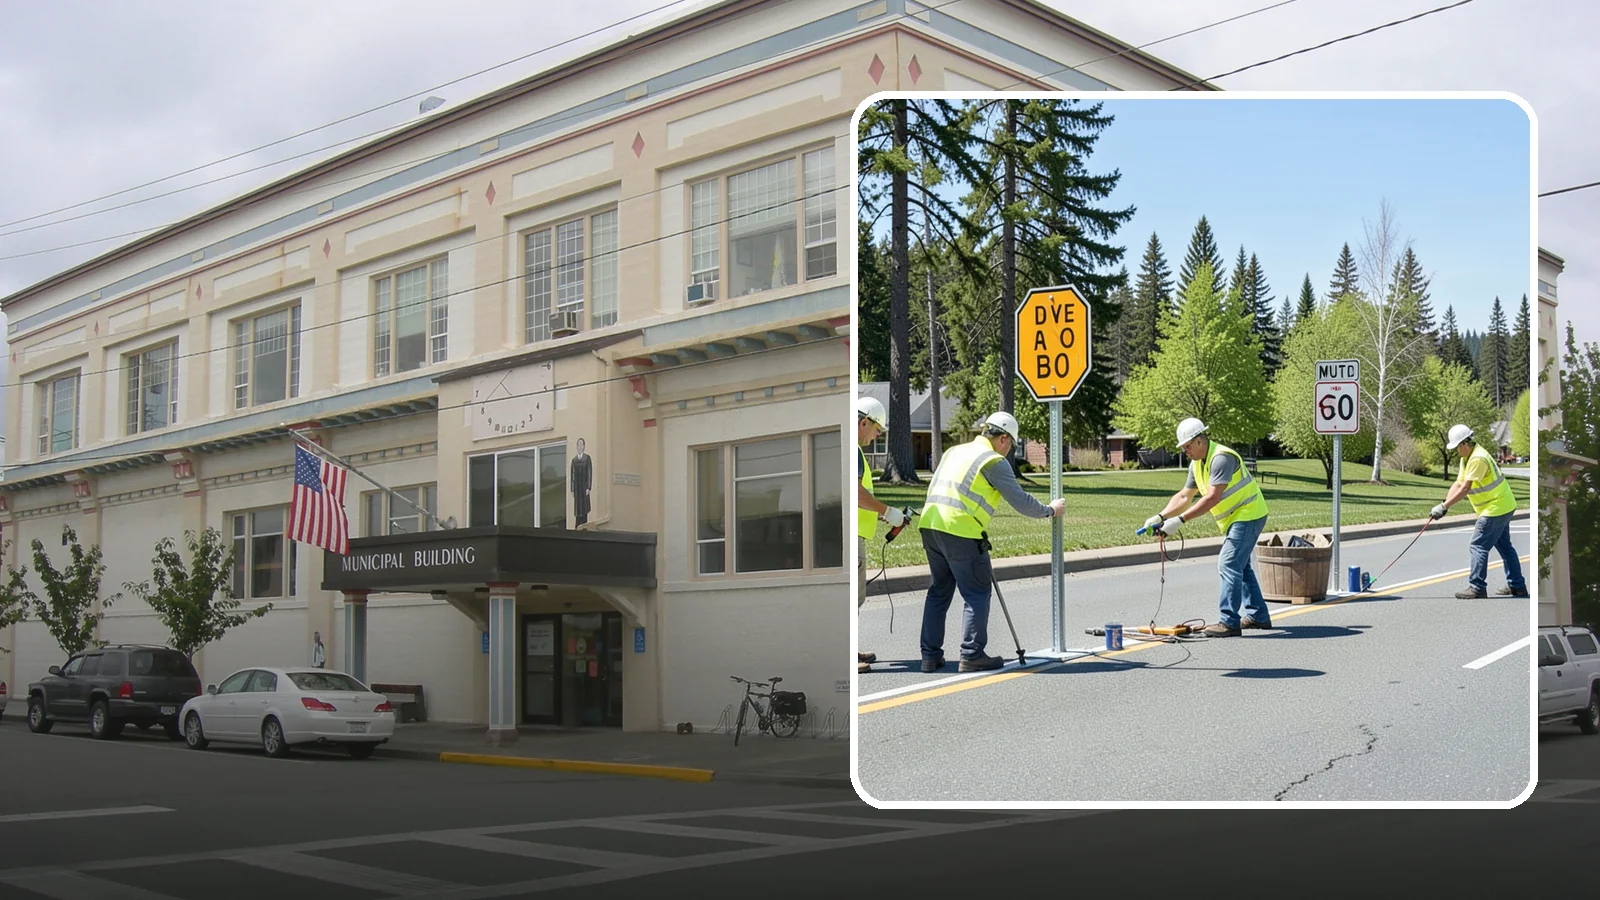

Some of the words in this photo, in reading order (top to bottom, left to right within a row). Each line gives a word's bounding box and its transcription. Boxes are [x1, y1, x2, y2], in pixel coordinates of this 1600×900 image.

[1035, 304, 1074, 325] DVE
[1034, 330, 1047, 351] A
[1060, 327, 1074, 348] O
[1037, 353, 1069, 379] BO
[1318, 394, 1353, 420] 60
[342, 552, 405, 572] MUNICIPAL
[414, 546, 475, 567] BUILDING
